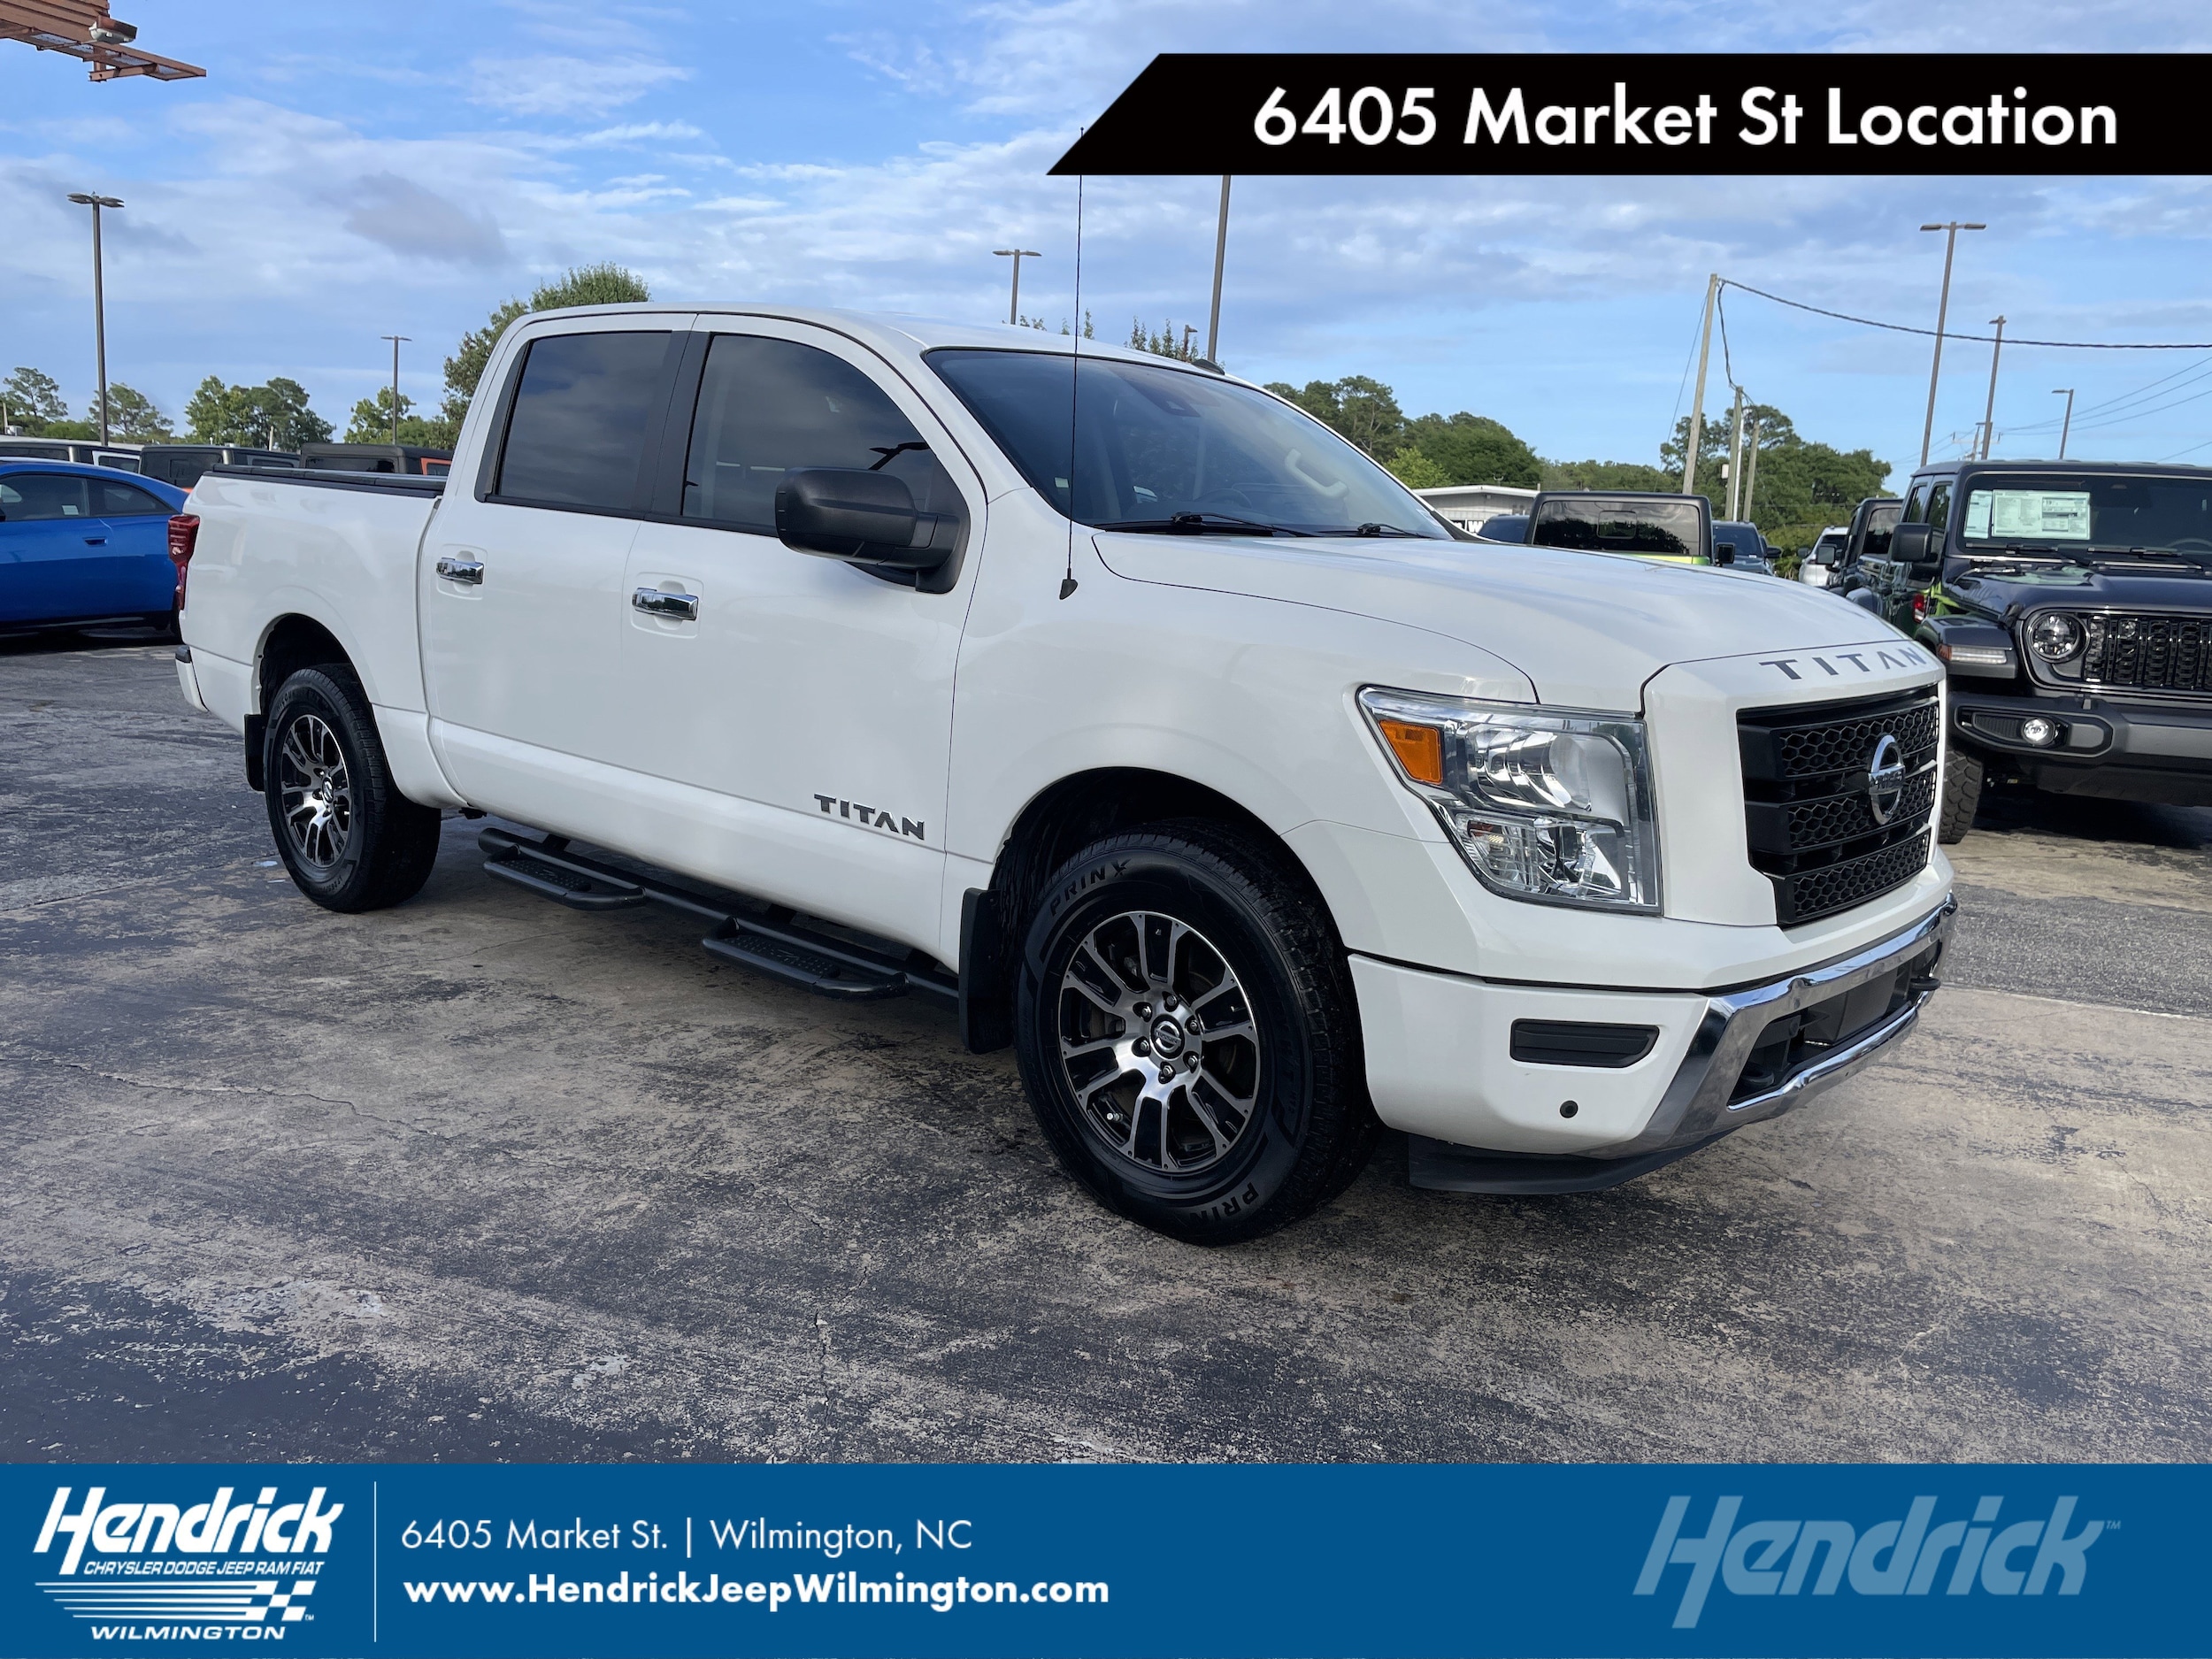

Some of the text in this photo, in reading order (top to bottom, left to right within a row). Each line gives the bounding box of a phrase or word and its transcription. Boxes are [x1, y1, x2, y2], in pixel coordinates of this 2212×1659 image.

[1758, 647, 1927, 680] TITAN
[814, 792, 925, 841] TITAN
[1050, 856, 1132, 917] PRINX
[1182, 1182, 1259, 1225] PRIN
